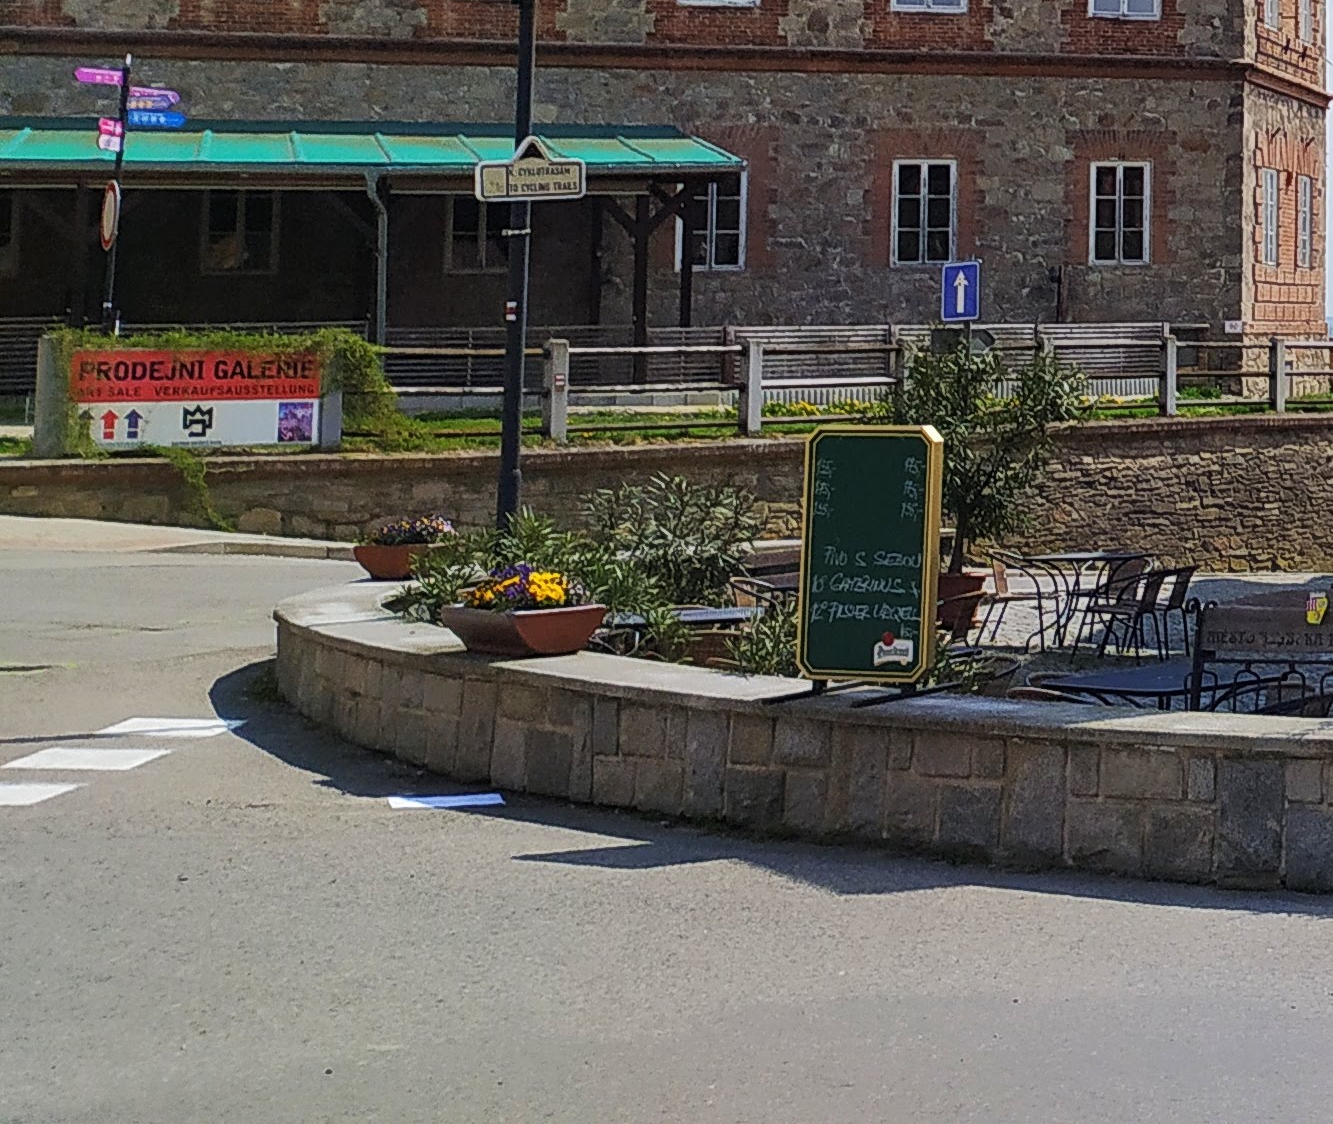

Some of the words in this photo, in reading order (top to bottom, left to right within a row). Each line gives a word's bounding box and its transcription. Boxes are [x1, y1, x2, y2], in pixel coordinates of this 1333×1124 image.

[521, 182, 550, 193] CYCLING
[553, 181, 578, 191] TRAILS
[213, 358, 314, 381] GALERIE
[108, 386, 142, 397] SALE
[154, 384, 315, 397] VERKAUFSAUSSTELLUNG
[854, 551, 867, 567] S
